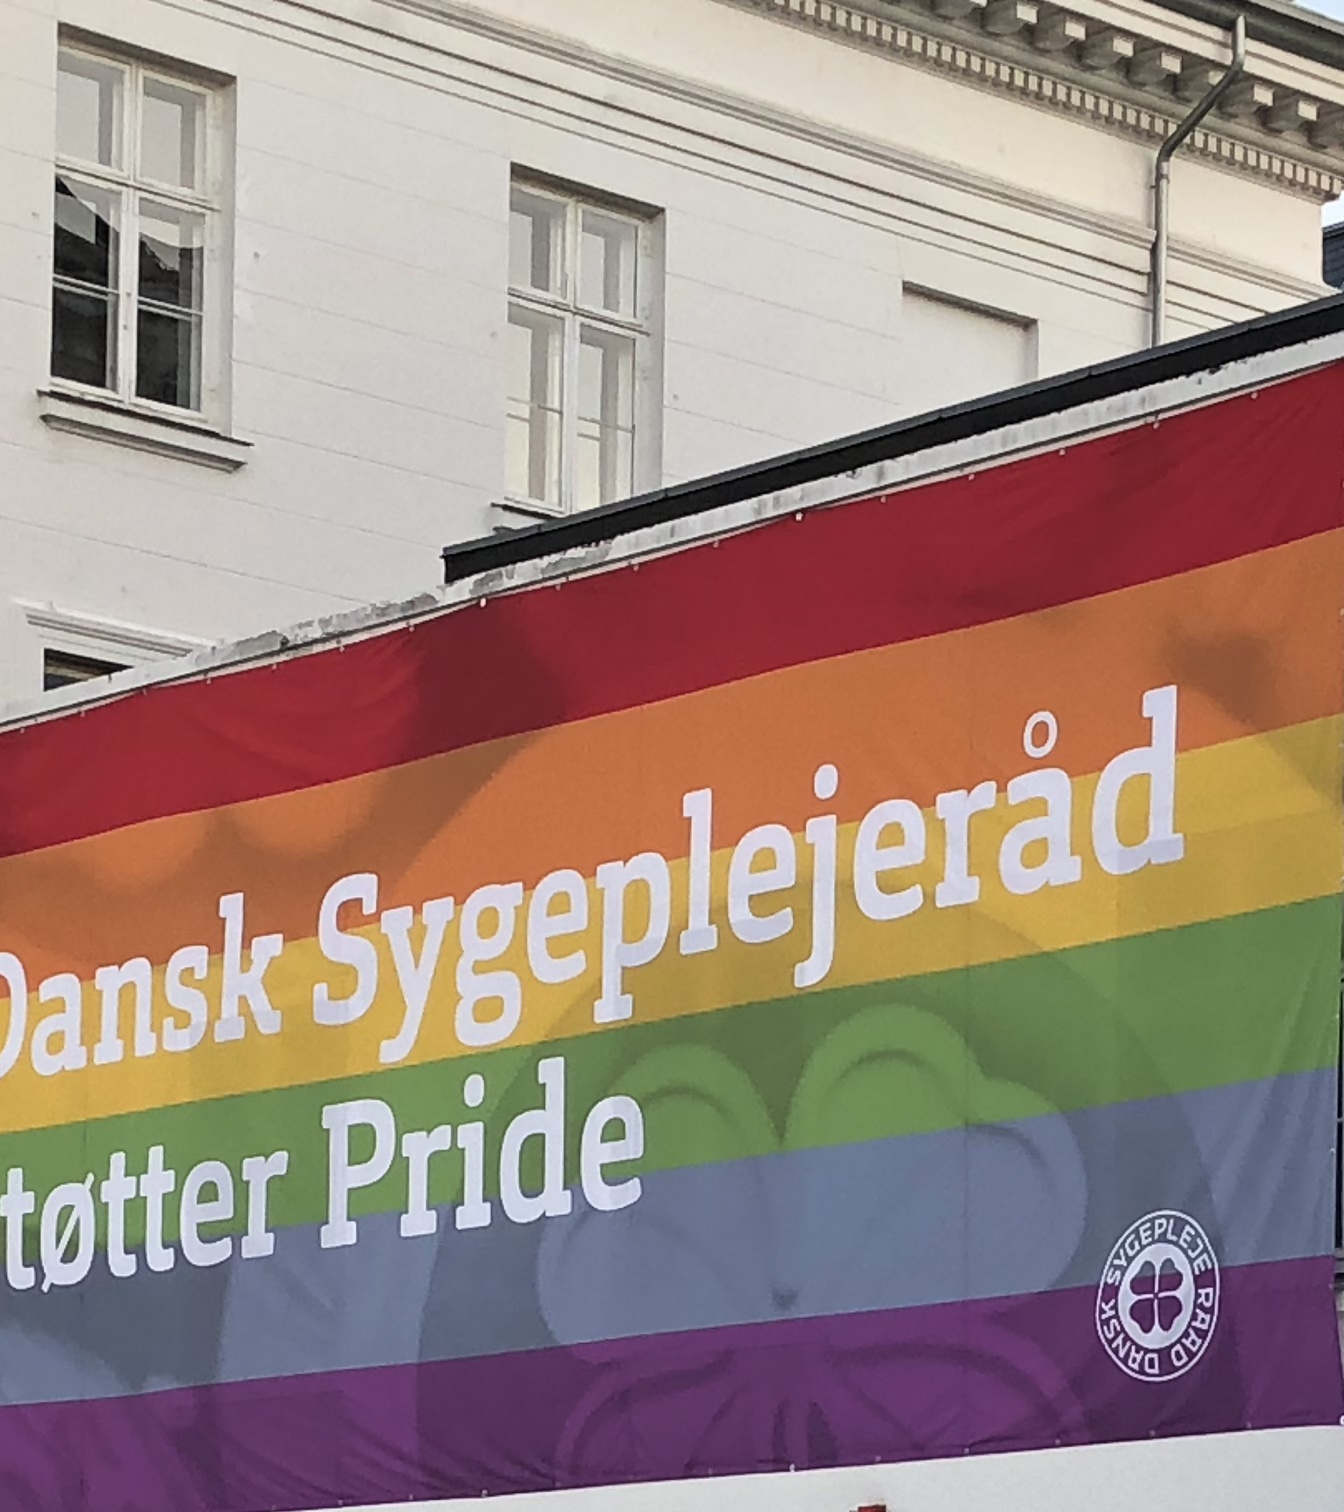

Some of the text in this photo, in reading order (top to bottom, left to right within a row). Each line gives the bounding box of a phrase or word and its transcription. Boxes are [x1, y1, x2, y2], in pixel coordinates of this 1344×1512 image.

[312, 683, 1185, 1065] Sygeplejeråd
[319, 1055, 645, 1250] Pride
[1100, 1217, 1214, 1374] DANSK SYGEPLEJE RAAD
